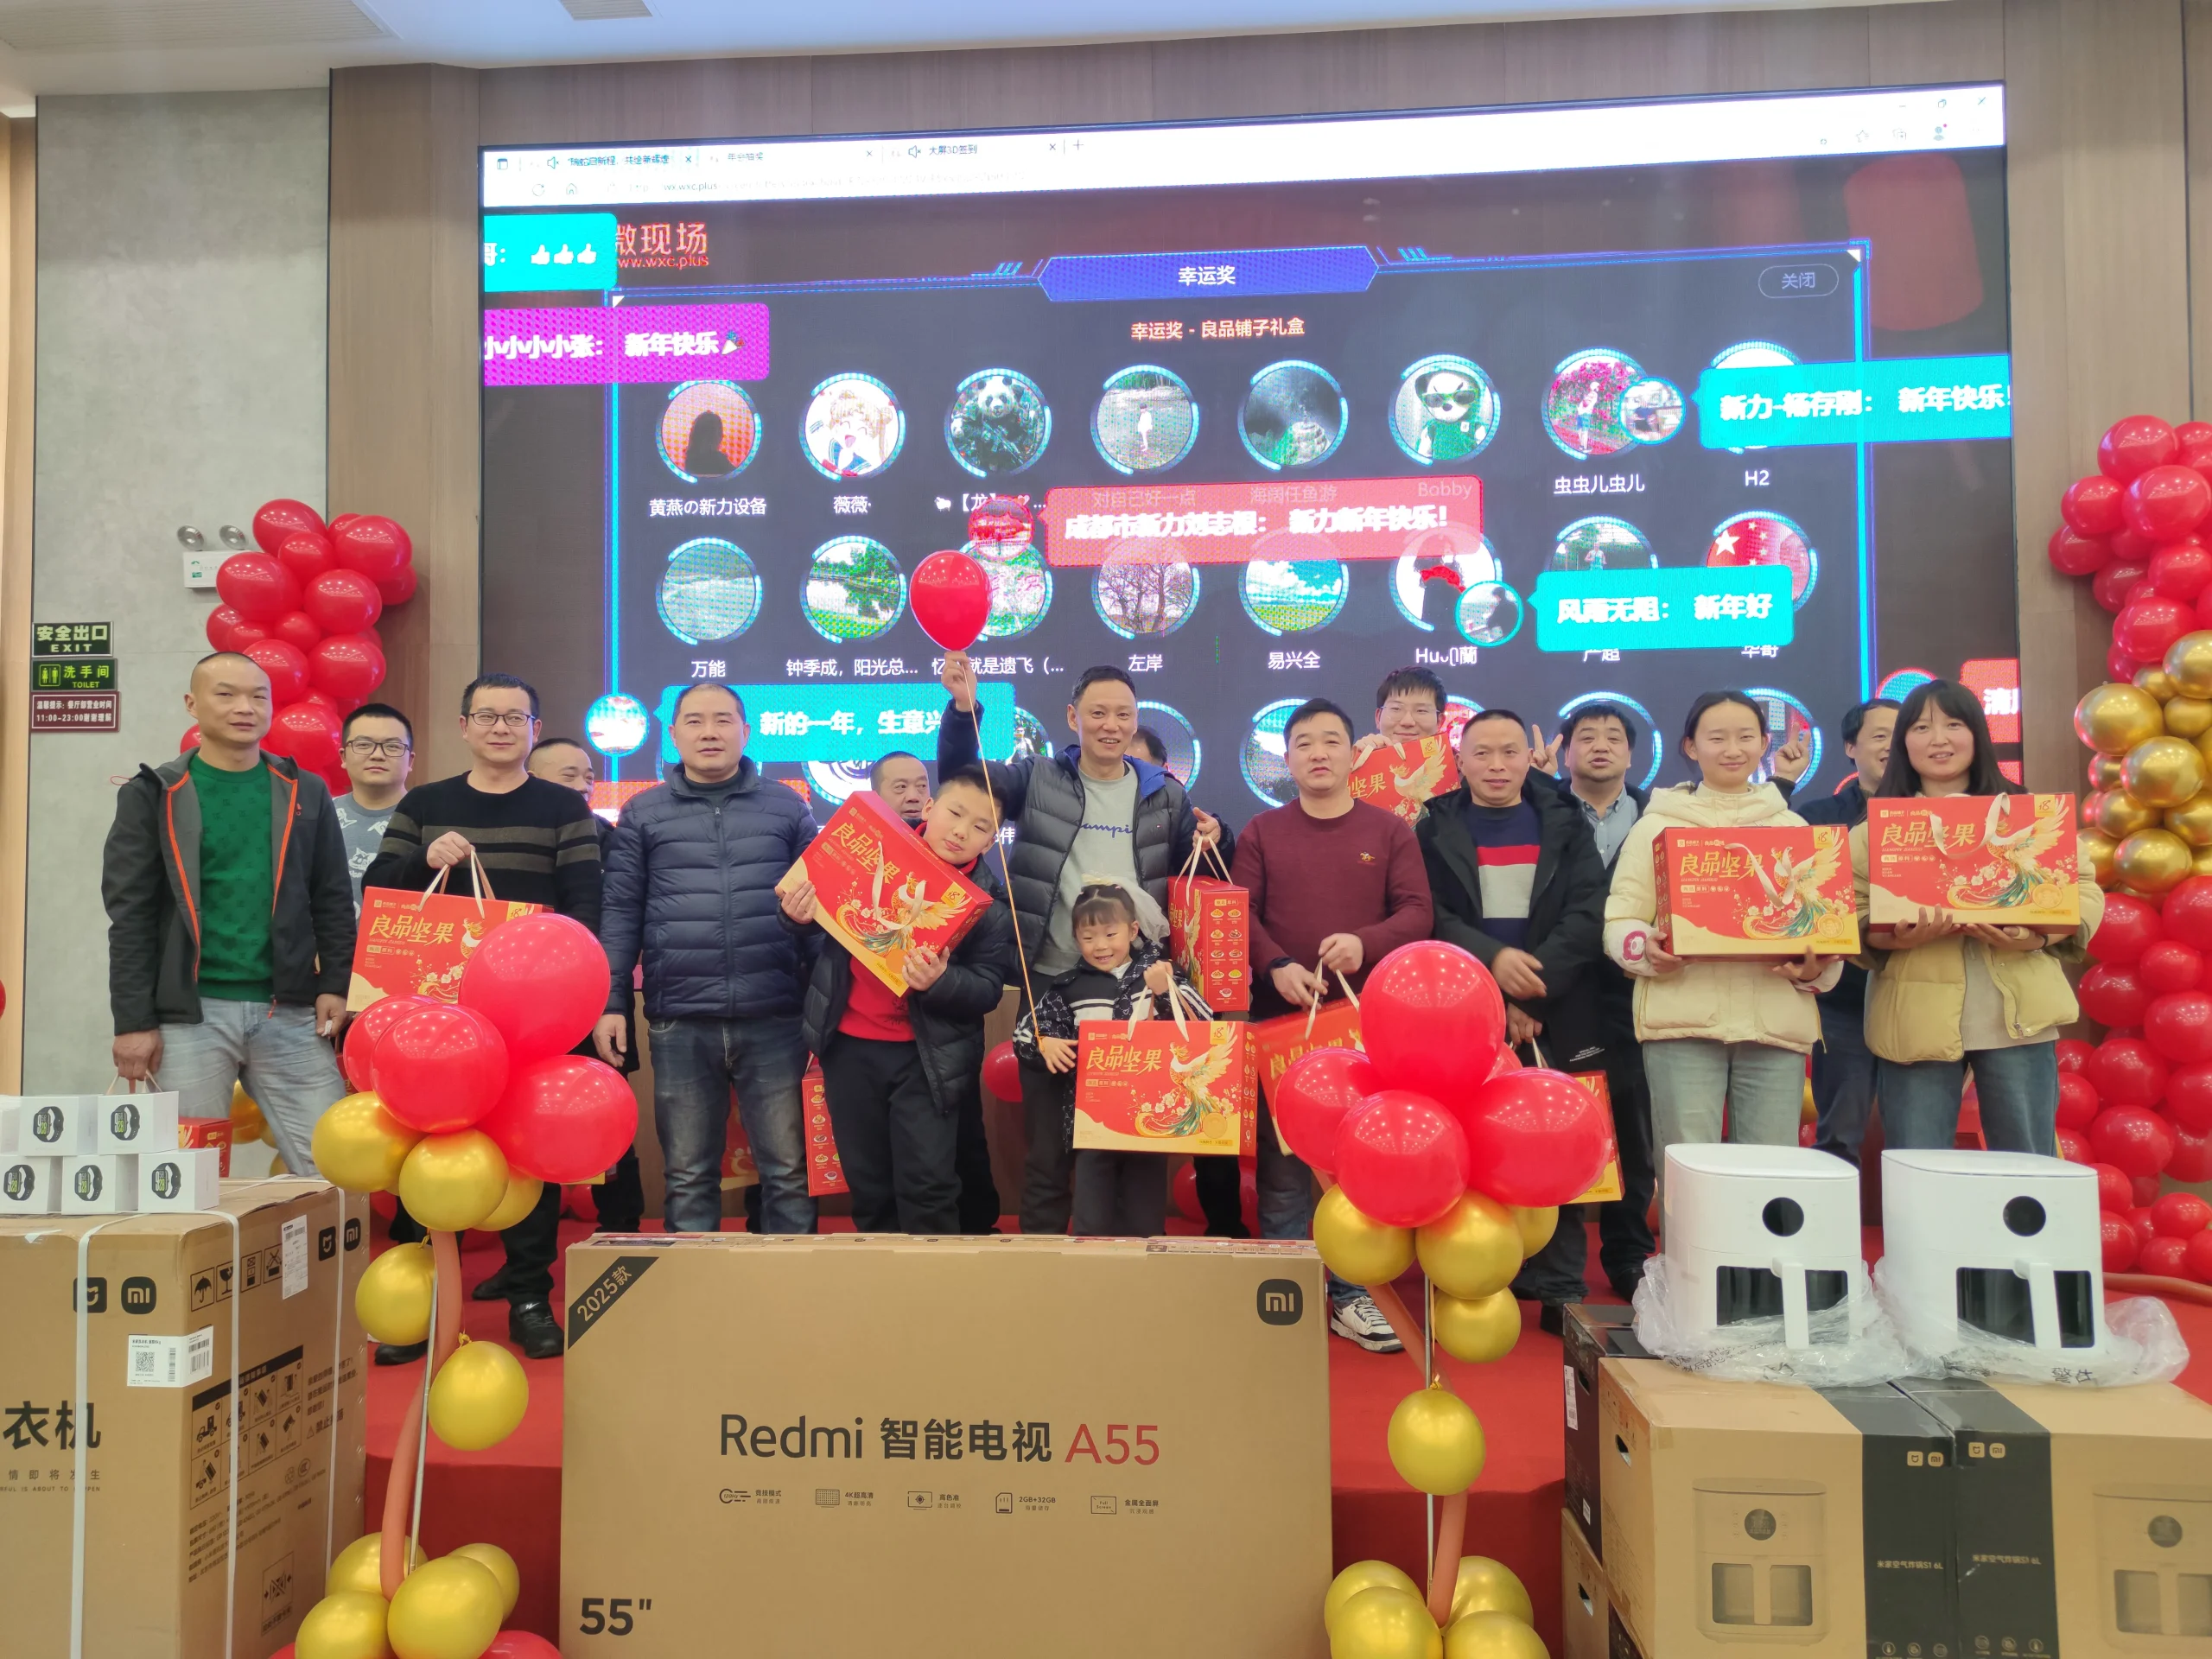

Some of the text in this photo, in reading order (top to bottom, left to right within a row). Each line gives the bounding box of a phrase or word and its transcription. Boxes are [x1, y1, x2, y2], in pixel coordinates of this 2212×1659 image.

[617, 254, 709, 270] ww.wxc.plus
[1178, 265, 1236, 287] 幸运奖
[1781, 271, 1816, 290] 关闭
[1131, 321, 1184, 341] 幸运奖
[1201, 317, 1305, 338] 良品铺子礼盒
[624, 331, 720, 358] 新年快乐
[1554, 474, 1645, 495] 虫虫儿虫儿
[1745, 469, 1770, 487] H2
[1093, 489, 1197, 509] 对自己好一点
[1418, 481, 1473, 499] Bobby
[649, 498, 767, 517] 黄燕の新力设备
[1694, 592, 1773, 620] 新年好
[37, 625, 108, 641] 安全出口
[50, 644, 92, 652] EXIT
[691, 659, 726, 677] 万能
[1128, 653, 1163, 672] 左岸
[1268, 651, 1321, 670] 易兴全
[63, 665, 110, 678] 洗手间
[1346, 772, 1387, 799] 坚果
[1880, 821, 1976, 850] 良品坚果
[830, 822, 901, 885] 良品坚果
[1679, 850, 1764, 880] 良品坚果
[368, 913, 455, 946] 良品坚果
[1085, 1045, 1163, 1076] 良品坚果
[576, 1265, 632, 1322] 2025款
[721, 1414, 1160, 1466] Redmi 智能电视 A55
[939, 1493, 960, 1502] 高色准
[1124, 1498, 1160, 1507] 金属全面屏
